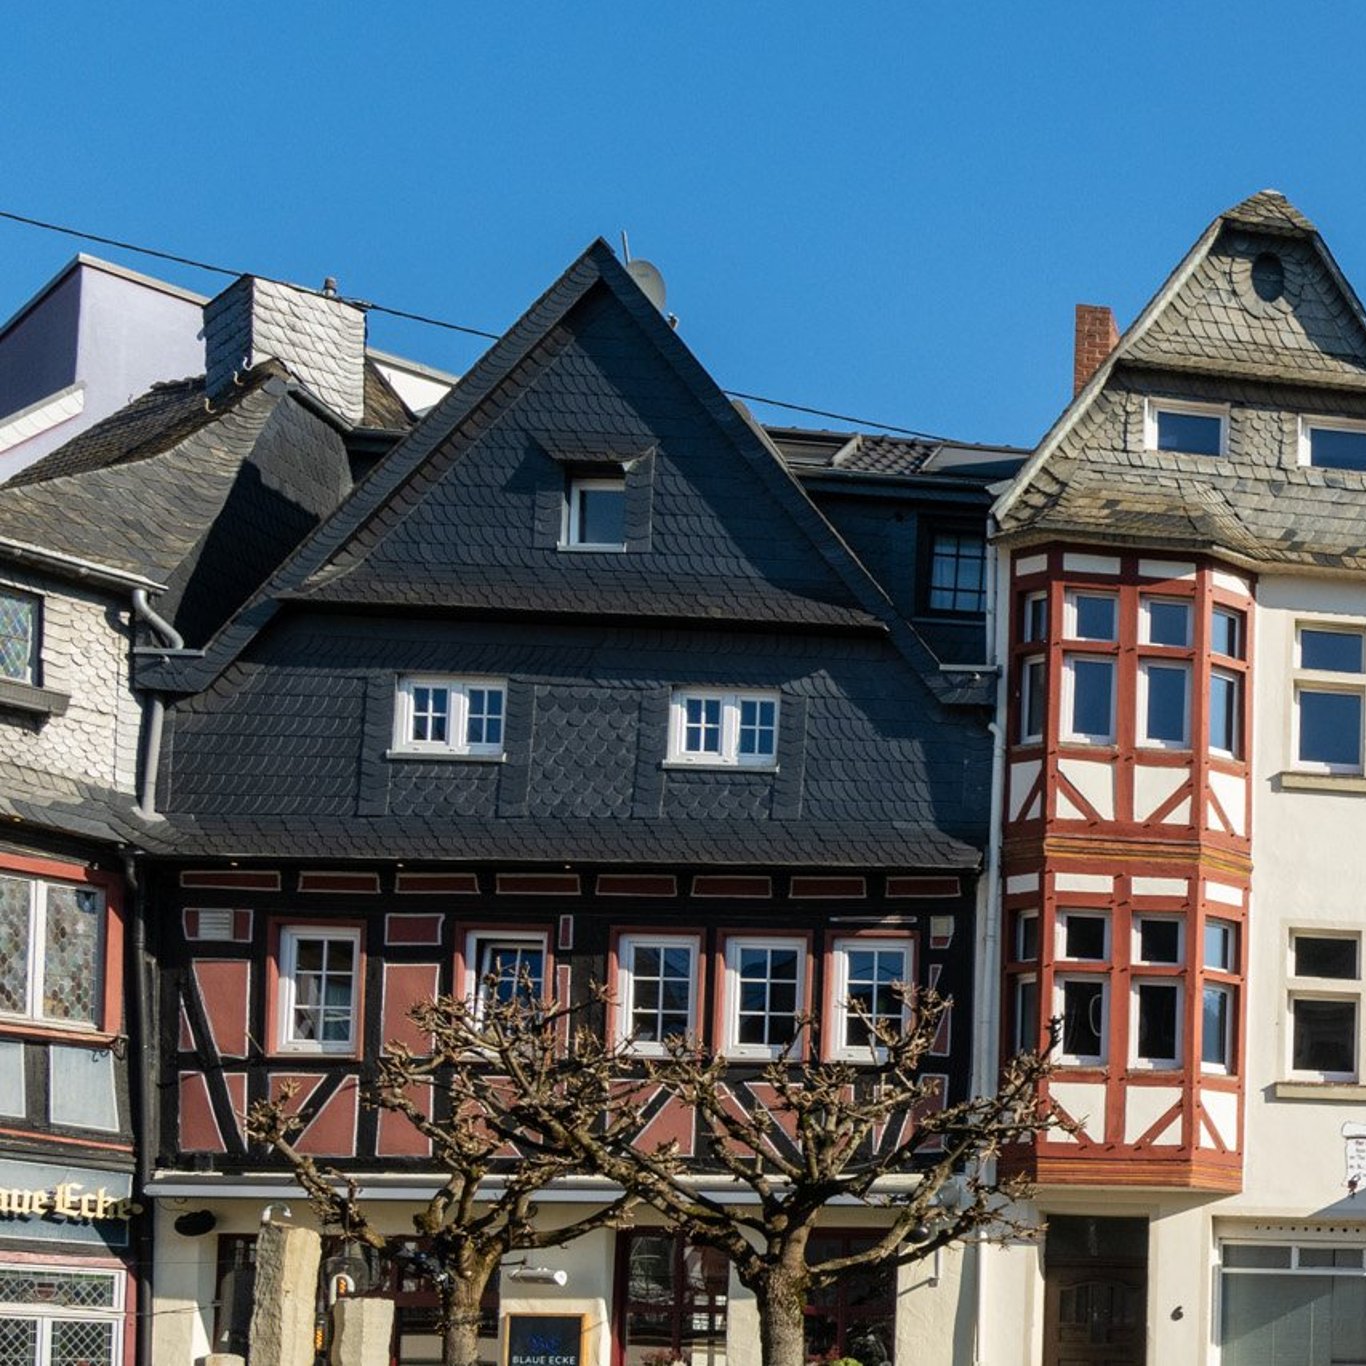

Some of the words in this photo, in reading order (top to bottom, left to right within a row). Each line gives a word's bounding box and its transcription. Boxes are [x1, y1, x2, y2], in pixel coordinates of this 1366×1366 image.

[54, 1182, 132, 1219] Ecke
[1170, 1305, 1184, 1321] 6
[511, 1355, 544, 1365] BLAUE
[548, 1355, 576, 1366] ECKE
